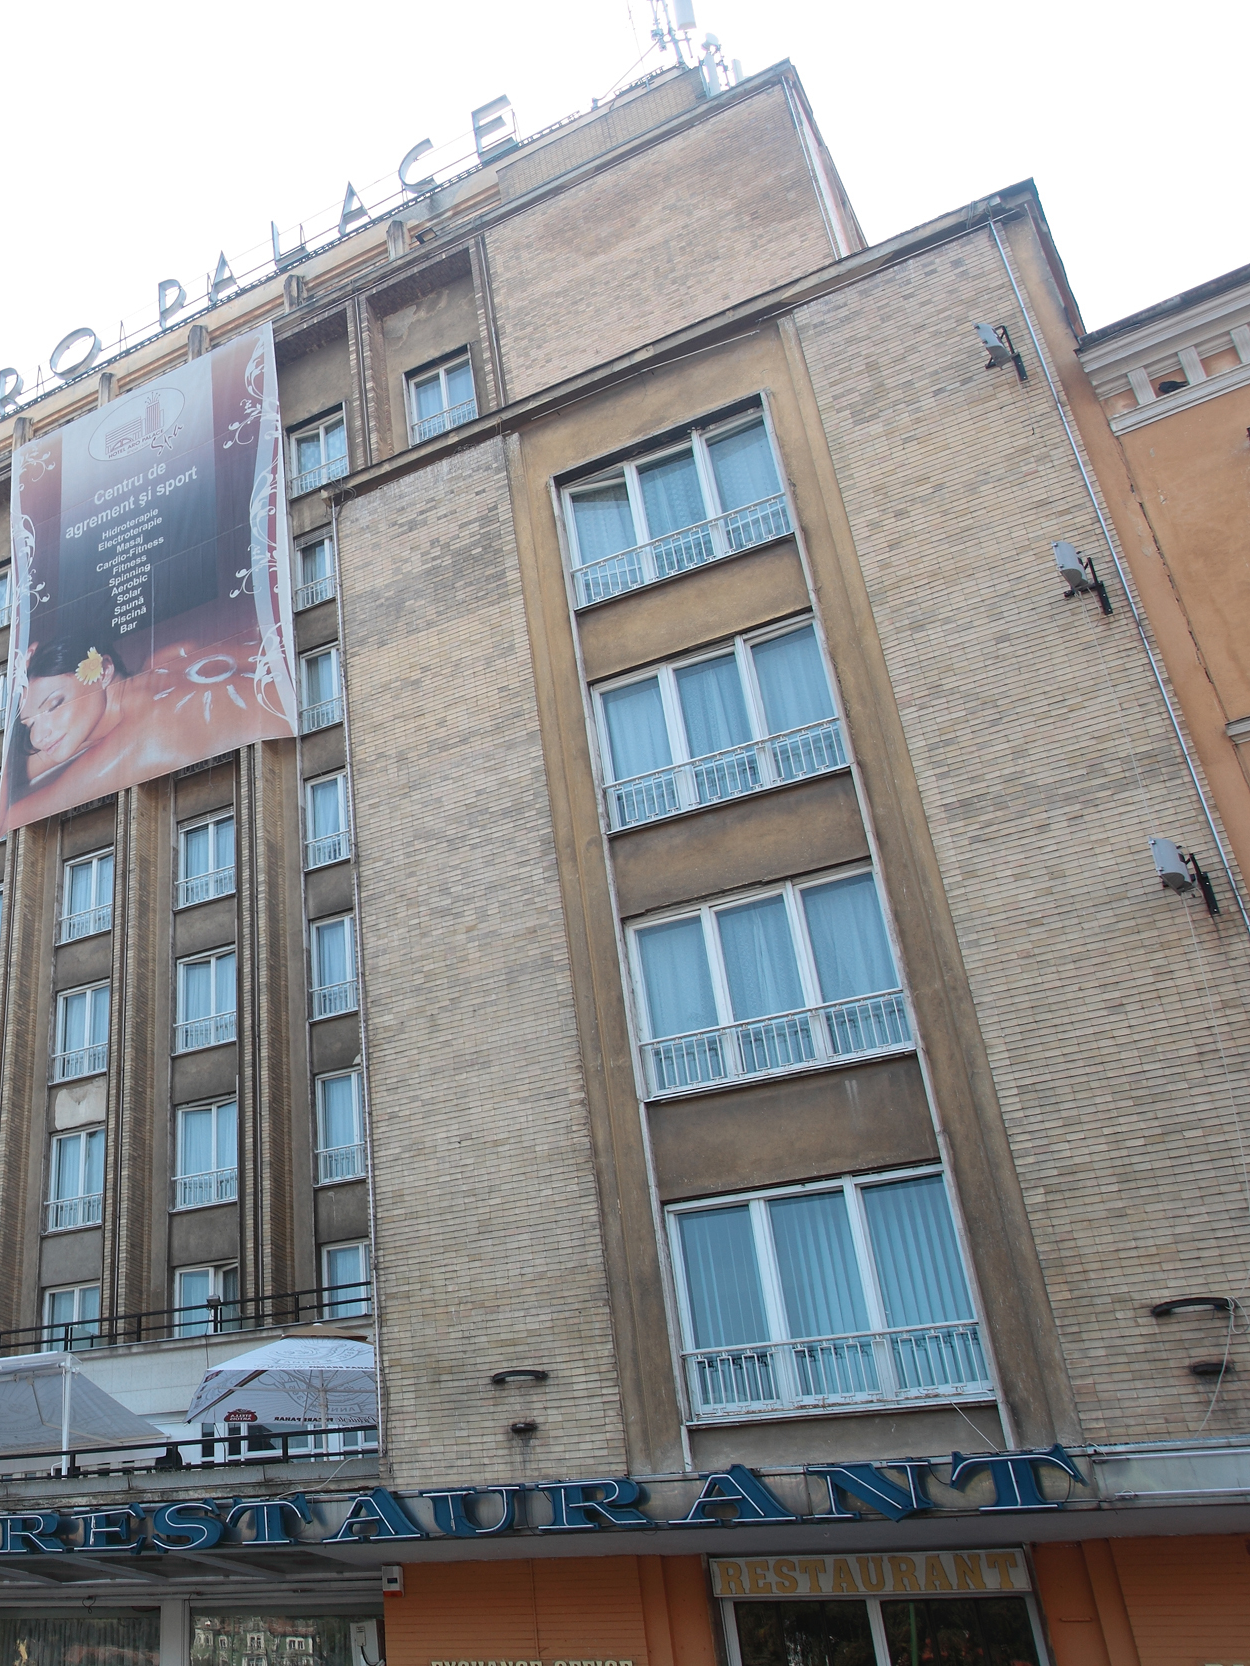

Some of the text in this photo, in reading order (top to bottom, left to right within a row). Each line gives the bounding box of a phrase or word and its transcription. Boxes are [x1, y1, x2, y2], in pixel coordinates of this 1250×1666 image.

[158, 93, 519, 329] PALACE
[108, 447, 126, 459] HOTEL
[127, 440, 140, 450] ARO
[142, 429, 164, 442] PALACE
[94, 462, 166, 505] Centru de
[65, 495, 135, 539] agrement
[156, 466, 197, 496] sport
[98, 517, 163, 552] Electroterapie
[102, 508, 159, 540] Hidroterapie
[96, 536, 164, 572] Cardio-Fitness
[116, 534, 144, 553] Masaj
[109, 563, 151, 587] Spinning
[113, 554, 147, 575] Fitness
[111, 574, 148, 597] Aerobic
[117, 587, 142, 604] Solar
[111, 605, 147, 628] Piscină
[114, 595, 144, 615] Saună
[120, 621, 138, 634] Bar
[716, 1552, 1018, 1595] RESTAURANT
